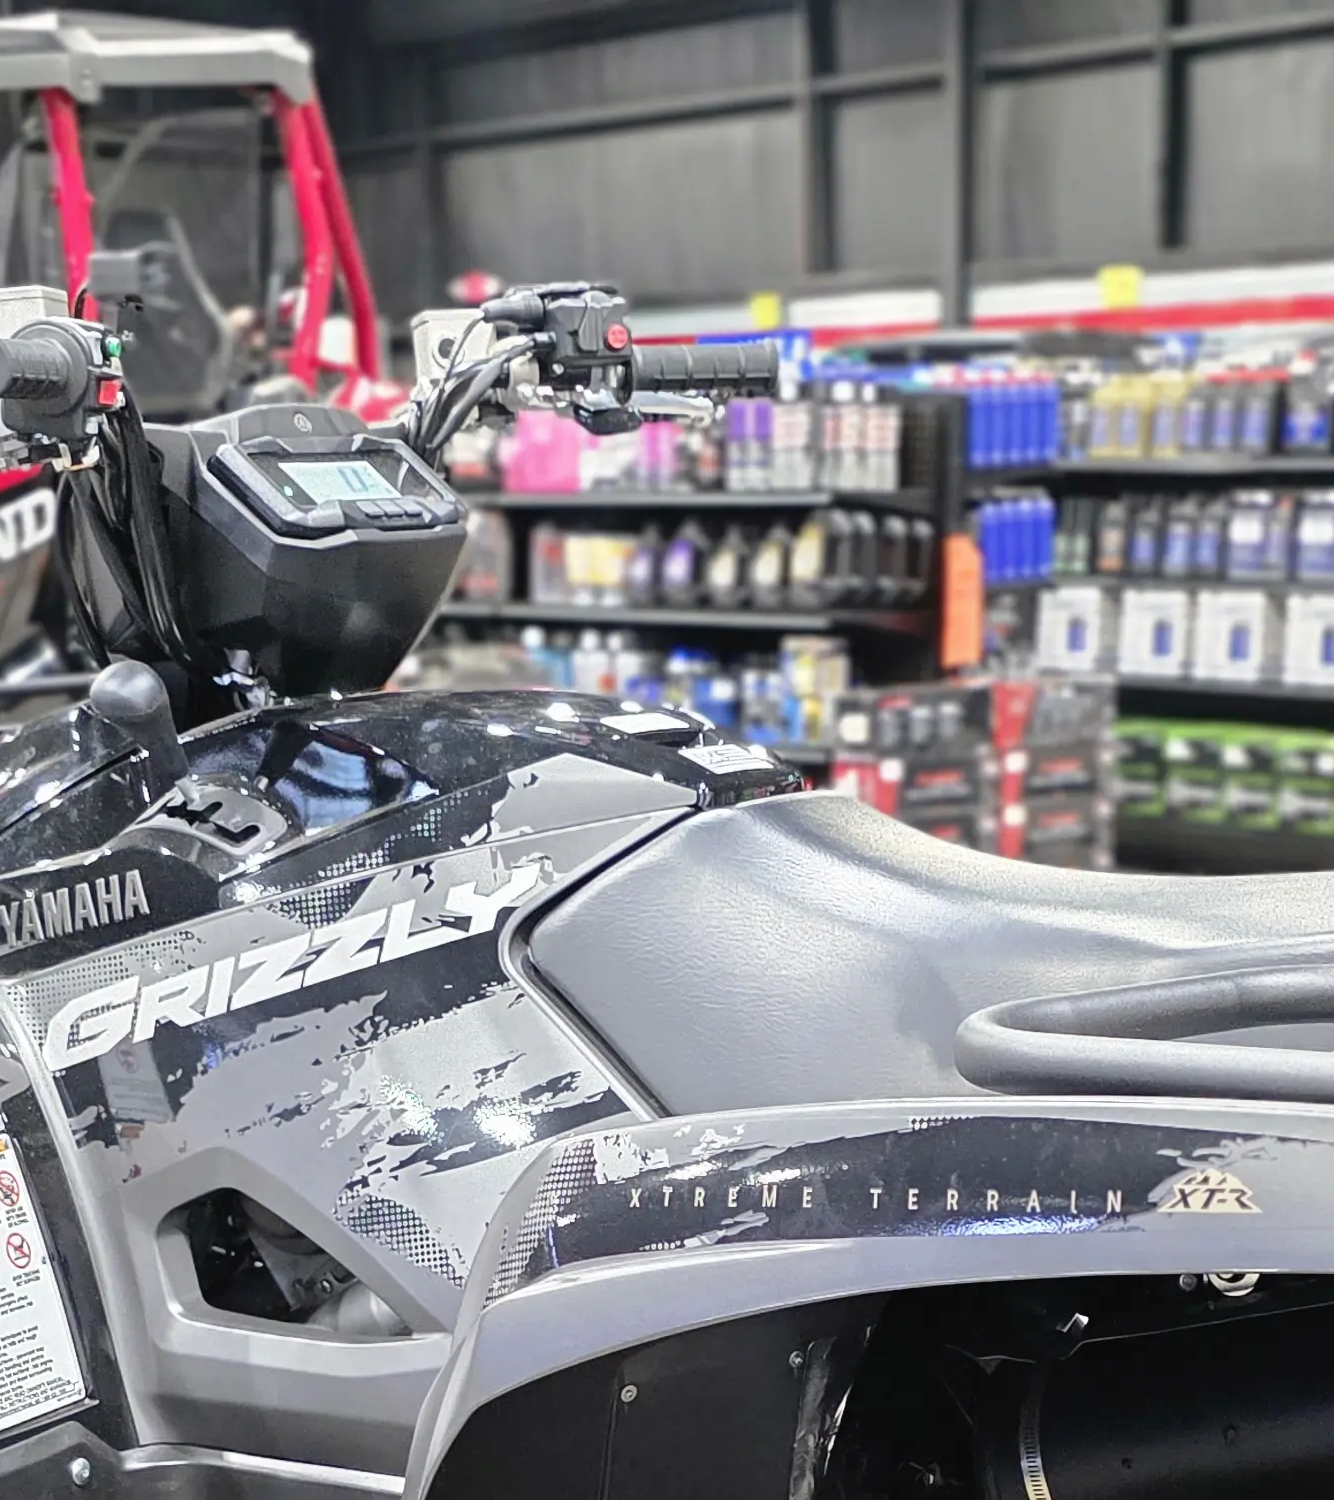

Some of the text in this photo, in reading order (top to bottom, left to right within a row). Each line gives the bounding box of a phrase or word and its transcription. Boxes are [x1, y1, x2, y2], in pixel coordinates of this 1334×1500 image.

[43, 865, 541, 1072] GRIZZLY
[629, 1185, 1123, 1214] XTREME TERRAIN
